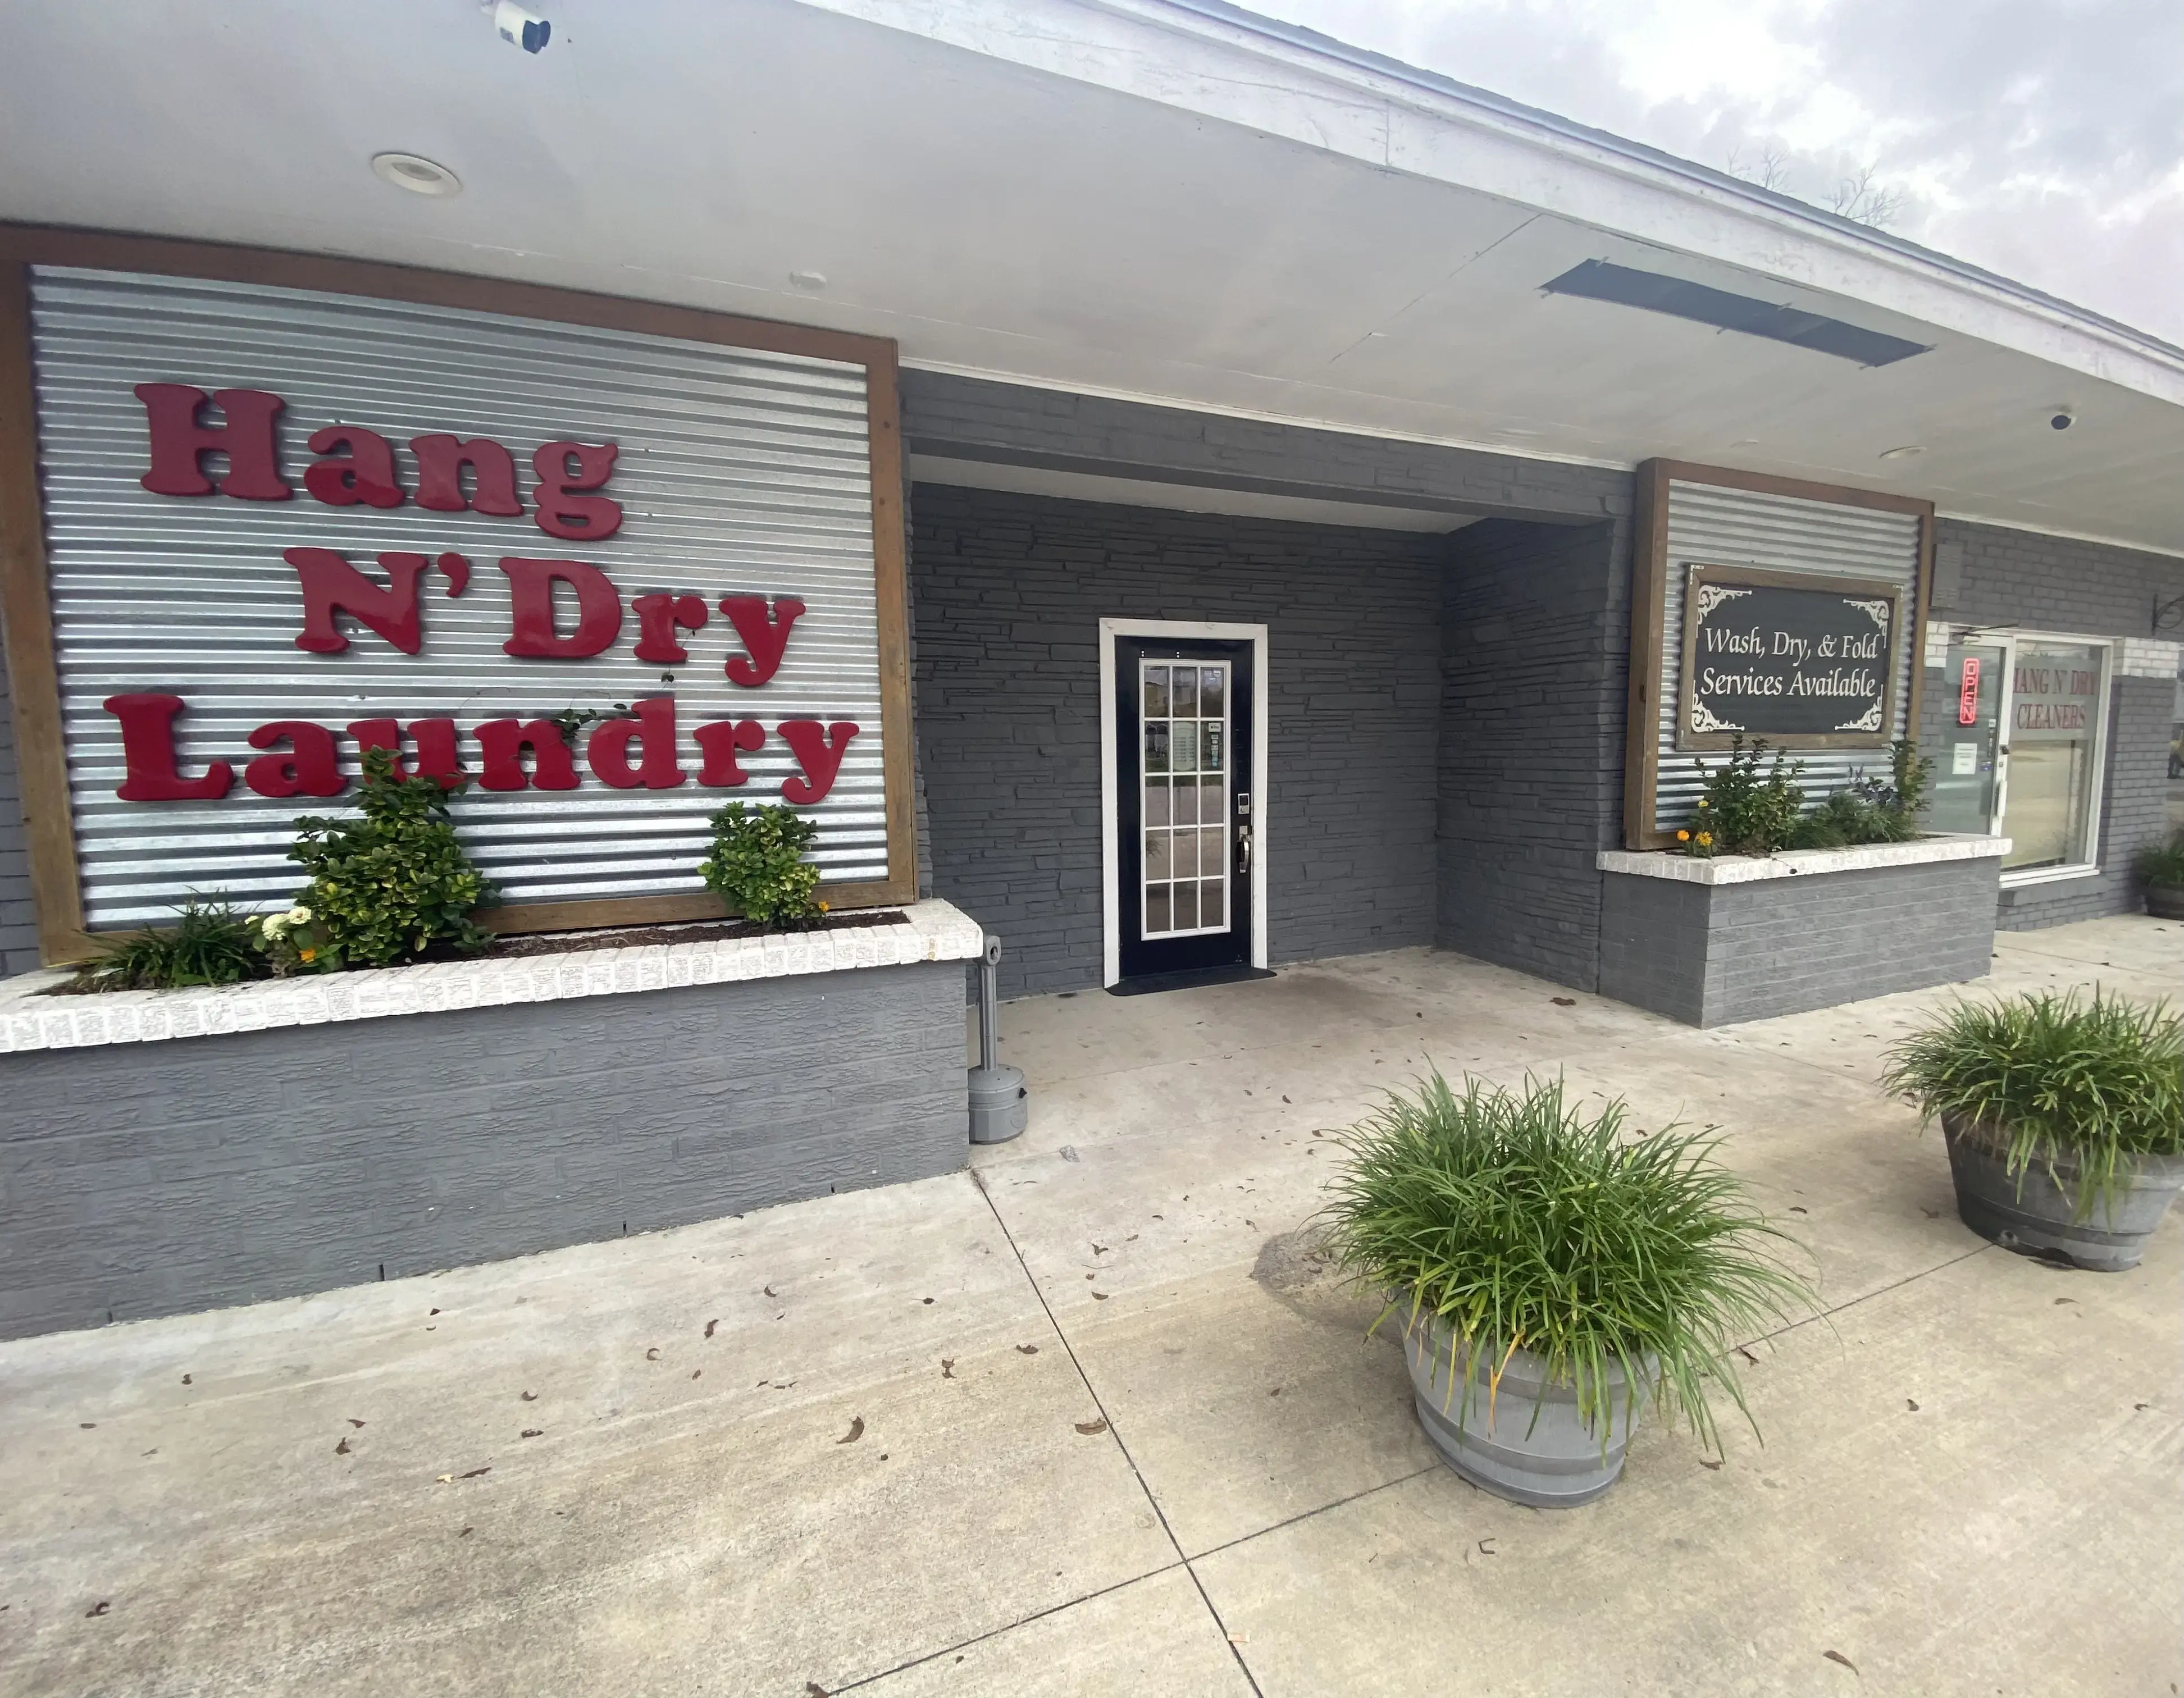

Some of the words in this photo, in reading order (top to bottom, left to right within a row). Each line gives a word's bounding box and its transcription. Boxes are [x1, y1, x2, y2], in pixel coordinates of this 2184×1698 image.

[134, 384, 622, 540] Hang
[1705, 627, 1765, 659] Wash,
[1771, 632, 1812, 667] Dry,
[1817, 635, 1837, 658] &
[1840, 632, 1880, 659] Fold
[1700, 667, 1784, 695] Services
[1786, 668, 1876, 697] Available
[1961, 661, 1977, 721] OPEN
[2017, 704, 2086, 729] CLEANERS
[103, 693, 859, 804] Laundry
